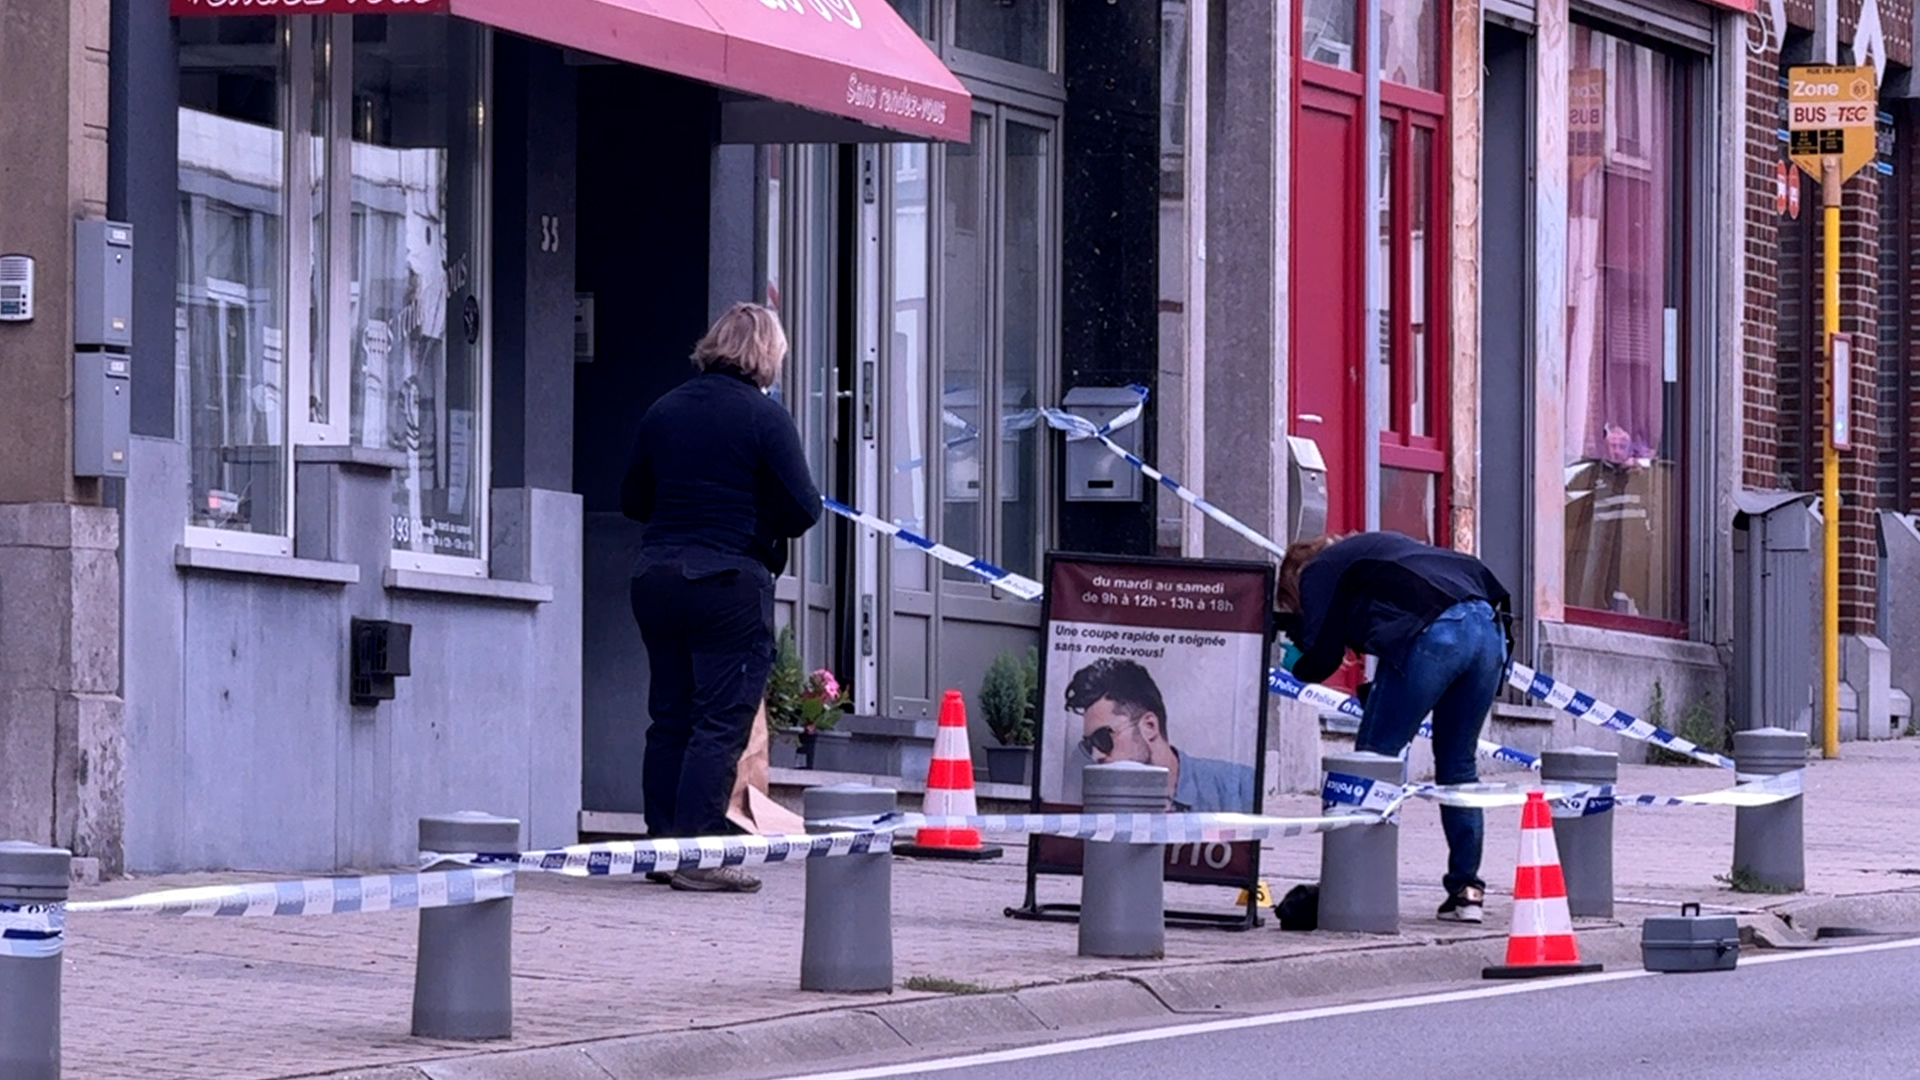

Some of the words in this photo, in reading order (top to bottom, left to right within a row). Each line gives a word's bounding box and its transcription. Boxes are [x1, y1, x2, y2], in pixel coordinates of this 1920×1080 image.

[846, 72, 877, 109] Sans
[878, 85, 947, 125] rendez-vous
[1793, 81, 1839, 97] Zone
[1794, 106, 1827, 123] BUS
[1093, 575, 1110, 587] du
[1114, 578, 1152, 591] mardi
[1156, 582, 1172, 592] au
[1176, 582, 1225, 594] samedi
[1082, 592, 1098, 604] de
[1101, 593, 1118, 605] 9h
[1121, 594, 1130, 606] à
[1134, 595, 1157, 607] 12h
[1170, 597, 1194, 610] 13h
[1198, 598, 1206, 610] à
[1210, 600, 1234, 612] 18h
[1055, 625, 1079, 637] Une
[1081, 628, 1119, 641] coupe
[1121, 629, 1160, 644] rapide
[1163, 633, 1175, 644] et
[1178, 635, 1226, 648] soignée
[1054, 642, 1083, 653] sans
[1085, 644, 1165, 659] rendez-vous!
[1275, 678, 1300, 695] Police
[1313, 692, 1337, 708] Police
